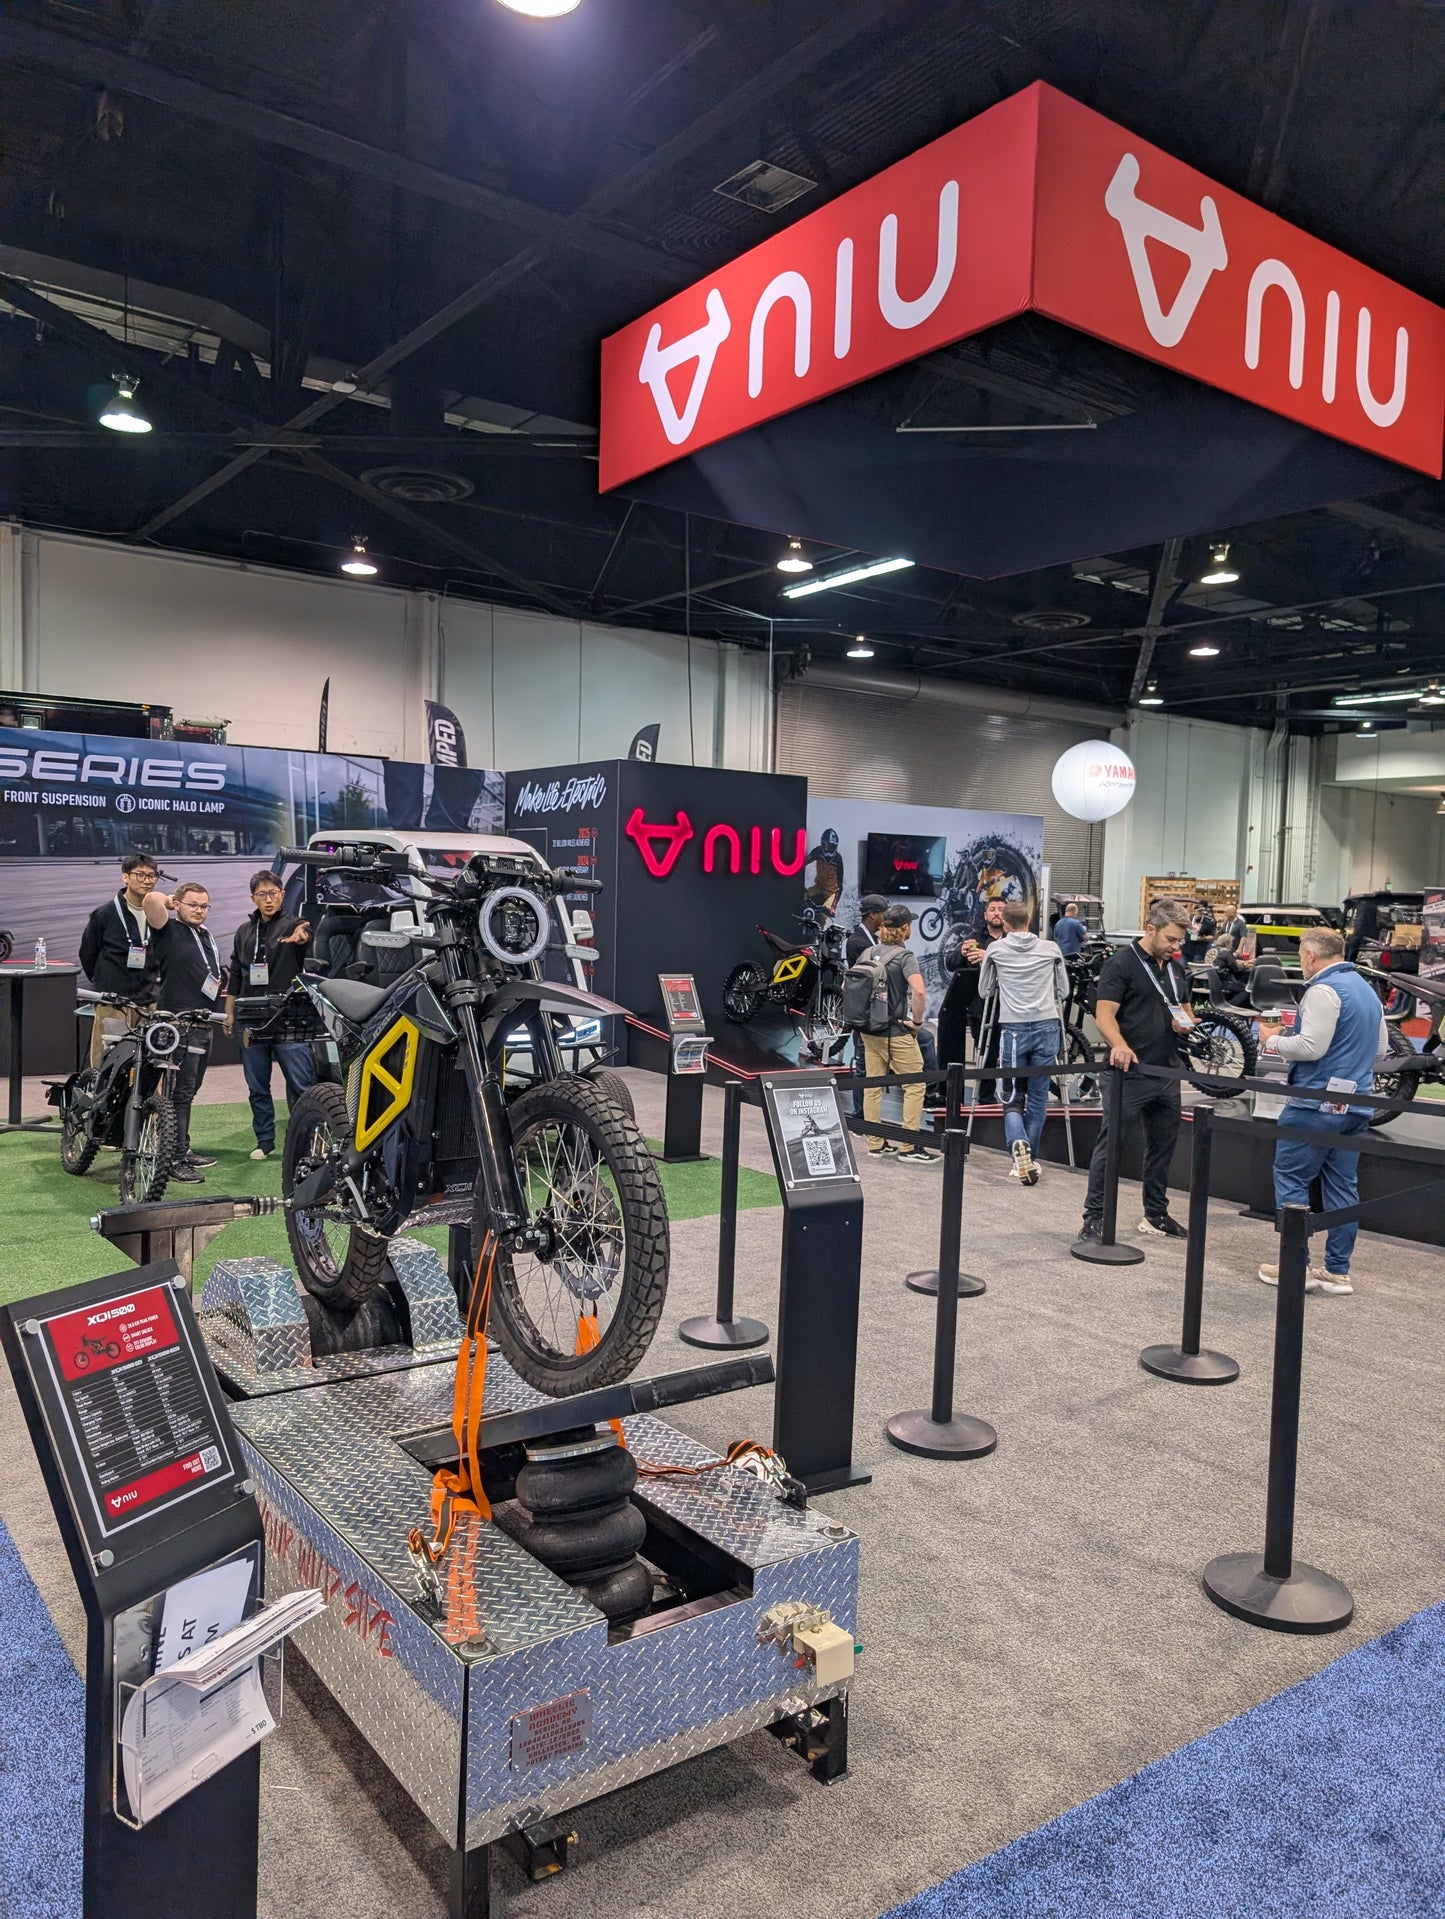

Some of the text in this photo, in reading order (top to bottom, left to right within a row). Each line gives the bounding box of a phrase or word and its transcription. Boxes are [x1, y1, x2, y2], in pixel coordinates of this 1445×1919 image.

[0, 747, 227, 791] SERIES
[1104, 764, 1136, 780] YAMA
[4, 790, 107, 808] FRONT SUSPENSION
[138, 798, 225, 814] ICONIC HALO LAMP
[789, 1106, 828, 1116] ON INSTAGRAM
[793, 1100, 813, 1108] FOLLOW
[182, 1461, 192, 1470] FIND
[190, 1463, 202, 1474] MORE
[529, 1699, 575, 1722] WHEELIE
[256, 1719, 267, 1731] TBD
[529, 1707, 578, 1731] ACADEMY
